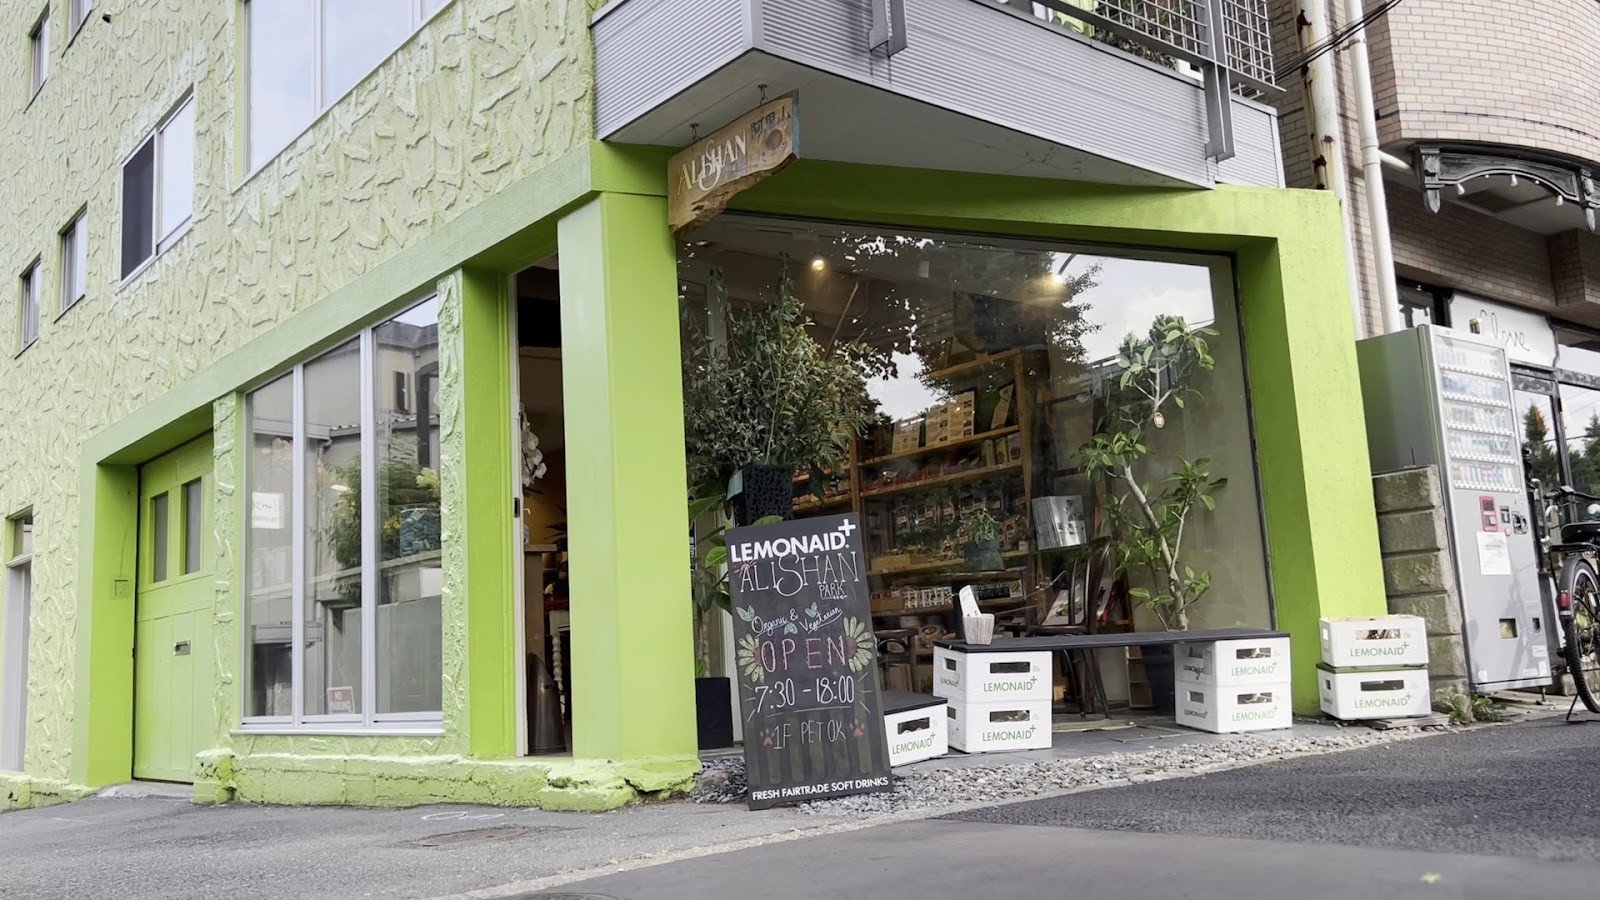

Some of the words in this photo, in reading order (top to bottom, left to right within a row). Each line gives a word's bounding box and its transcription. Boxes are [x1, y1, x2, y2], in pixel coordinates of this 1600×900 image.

[677, 131, 746, 195] ALISHAN
[740, 551, 859, 596] ALISHAN
[819, 581, 846, 599] PARK
[752, 616, 788, 636] Organic
[789, 608, 799, 621] &
[799, 607, 842, 631] Vegetarian
[761, 635, 845, 673] OPEN
[755, 678, 796, 713] 7:30
[816, 675, 855, 704] 18:00
[773, 723, 792, 750] 1F
[801, 719, 824, 744] PET
[827, 719, 847, 742] OK
[752, 788, 780, 801] FRESH
[782, 783, 829, 798] FAIRTRADE
[831, 780, 854, 792] SOFT
[855, 776, 889, 789] DRINKS
